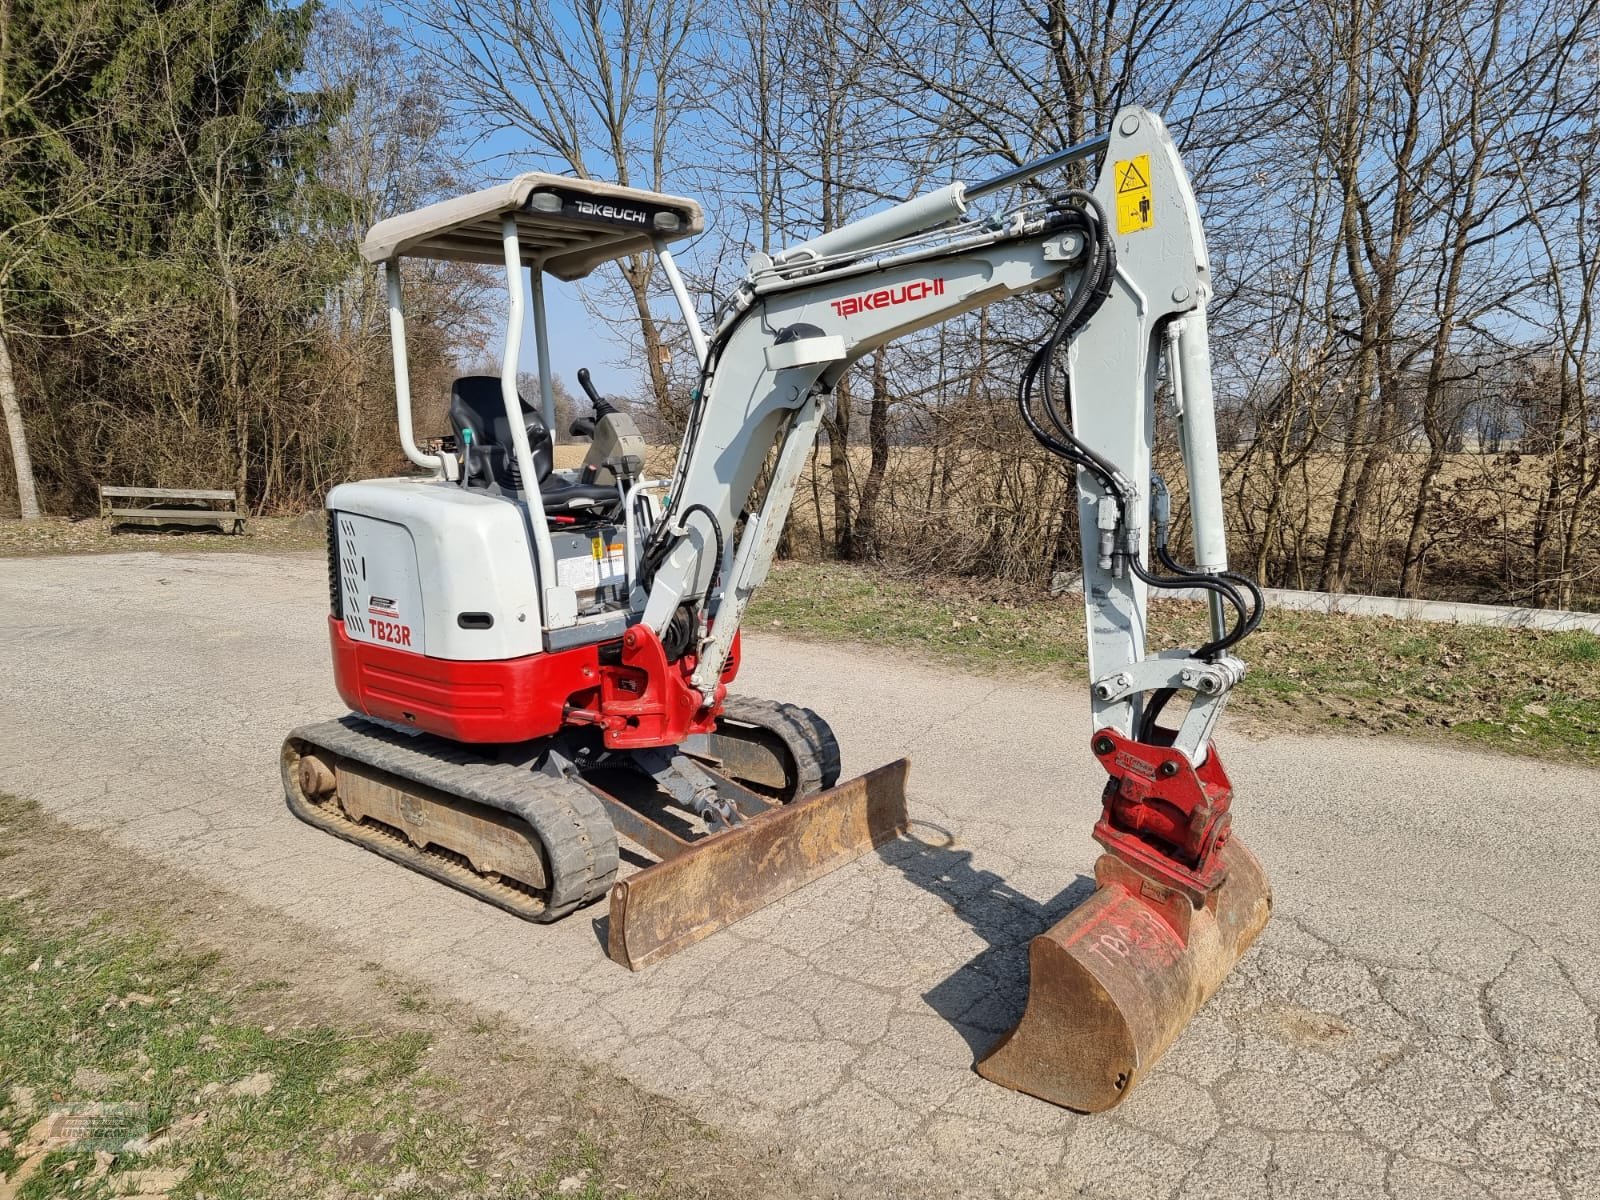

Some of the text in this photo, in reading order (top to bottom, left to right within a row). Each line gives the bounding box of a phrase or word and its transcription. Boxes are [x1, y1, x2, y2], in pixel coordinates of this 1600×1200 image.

[575, 200, 647, 223] TAKEUCHI
[831, 278, 944, 316] TAKEUCHI
[368, 618, 411, 646] TB23R
